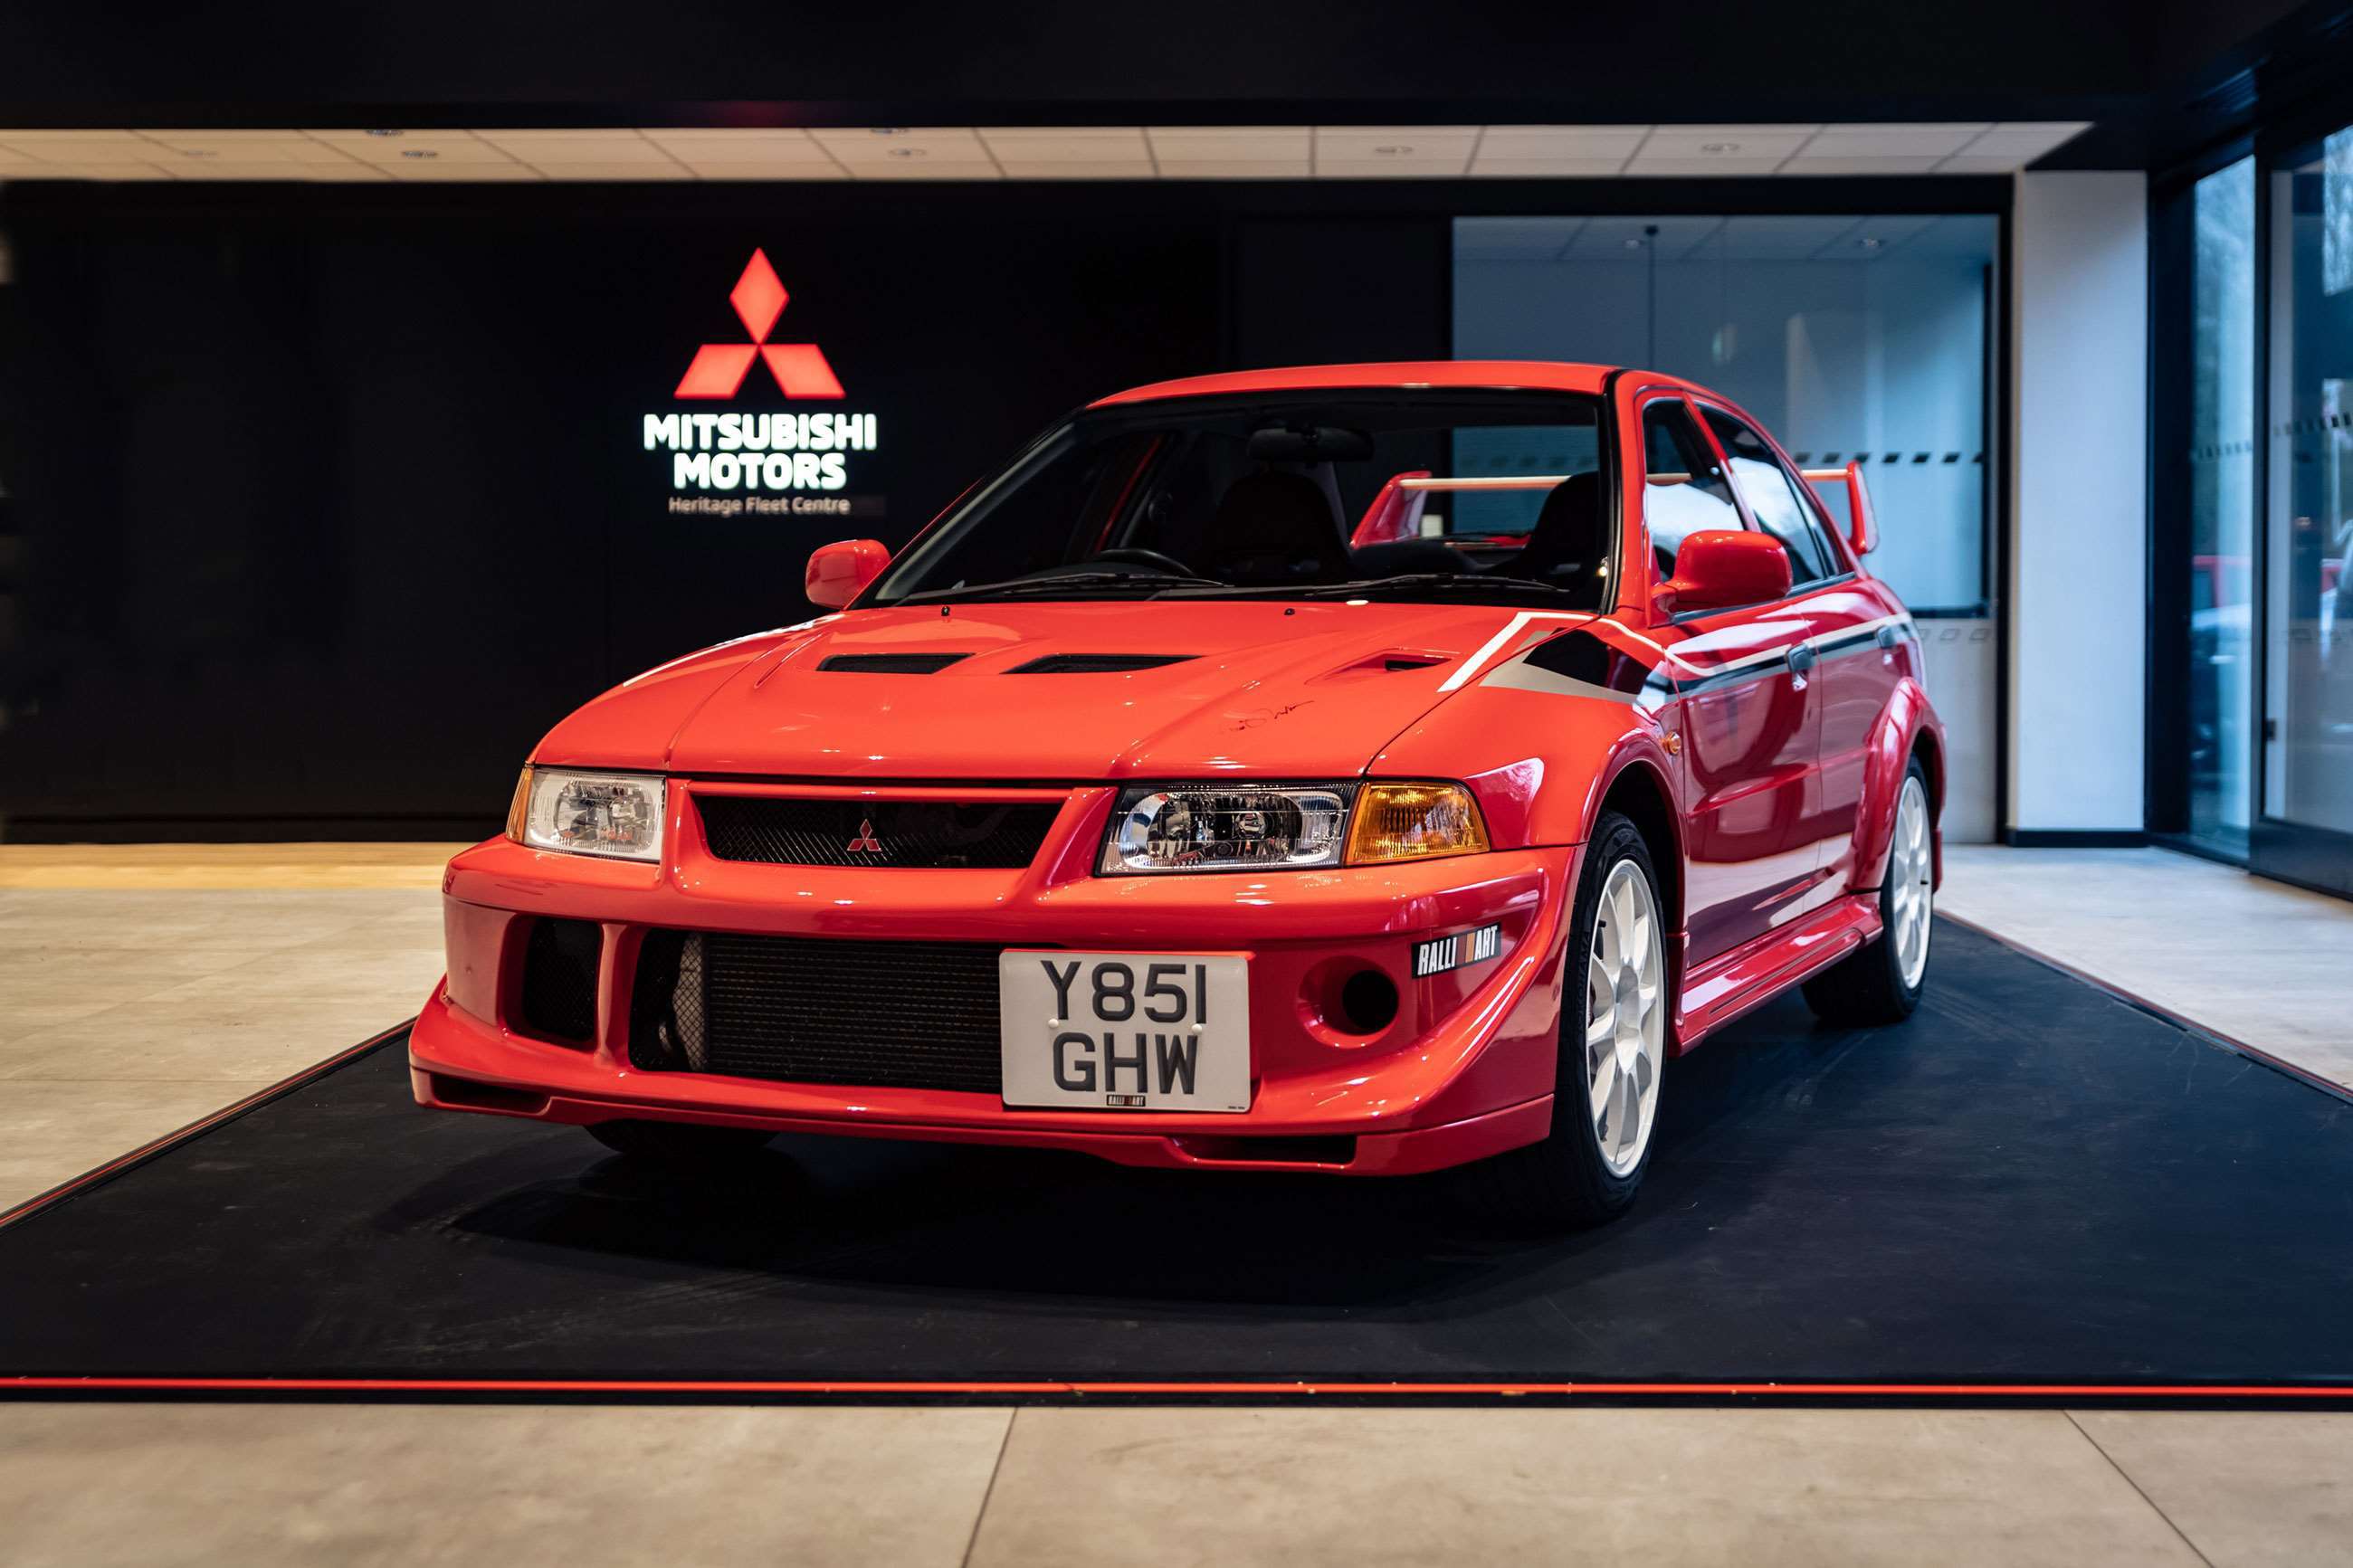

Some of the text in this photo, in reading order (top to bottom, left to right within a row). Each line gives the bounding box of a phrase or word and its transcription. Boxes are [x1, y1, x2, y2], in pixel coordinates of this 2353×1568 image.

[643, 413, 877, 451] MITSUBISHI
[673, 452, 848, 490] MOTORS
[669, 497, 852, 518] Heritage Fleet Centre
[1417, 925, 1499, 975] RALLI ART
[1041, 960, 1206, 1023] Y851
[1053, 1031, 1198, 1095] GHW
